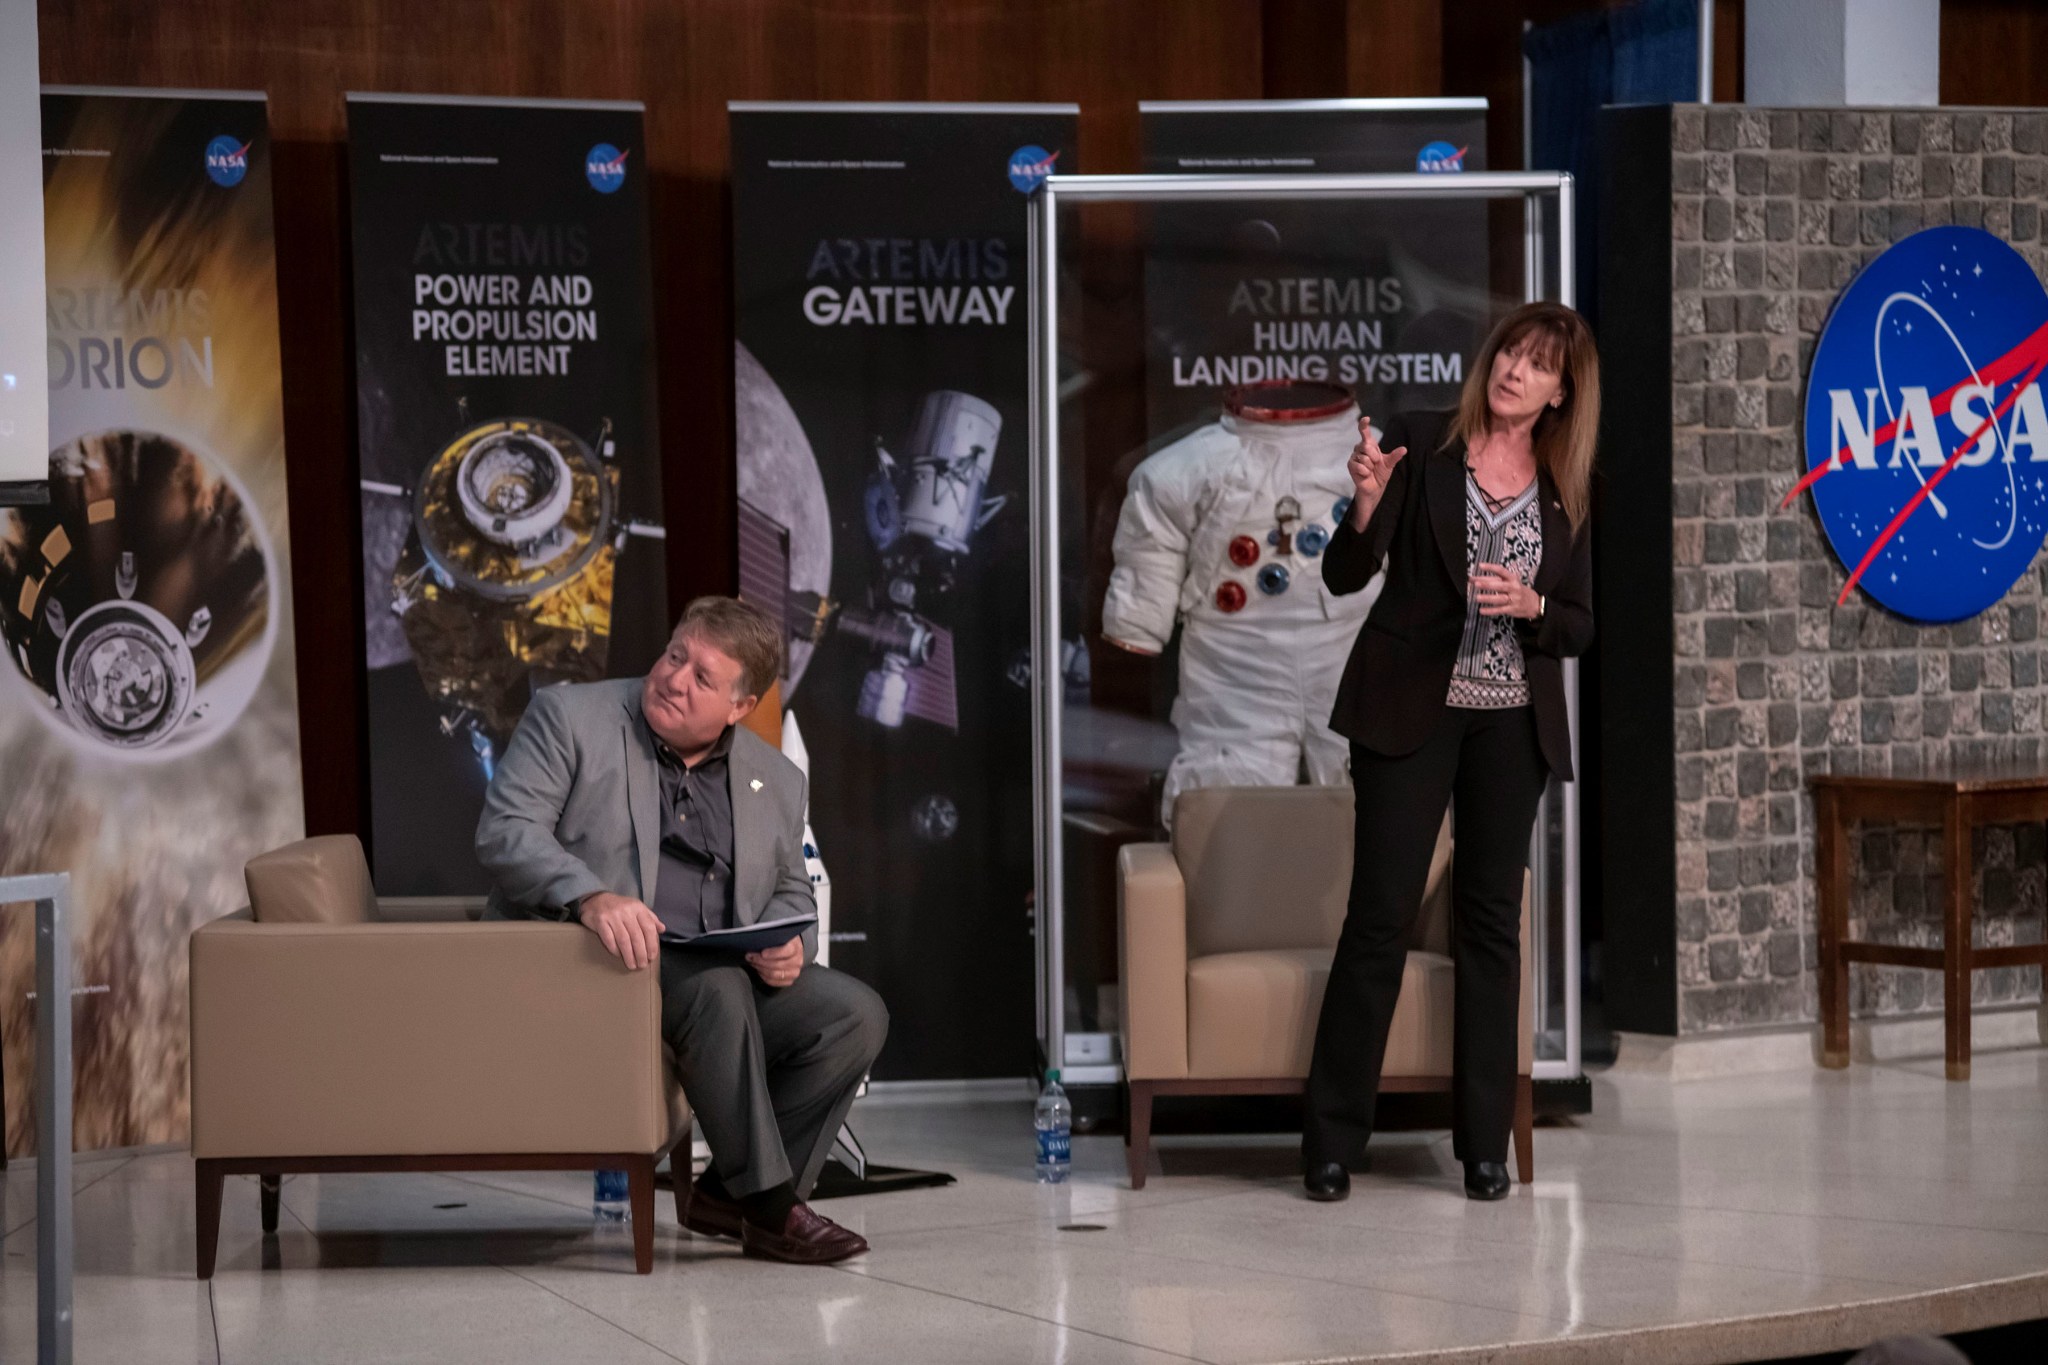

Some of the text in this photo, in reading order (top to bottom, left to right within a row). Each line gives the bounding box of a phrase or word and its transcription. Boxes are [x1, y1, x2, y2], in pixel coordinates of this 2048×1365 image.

[208, 155, 246, 168] NASA
[588, 162, 624, 174] NASA
[1011, 163, 1053, 176] NASA
[1420, 159, 1461, 172] NASA
[412, 222, 590, 267] ARTEMIS
[806, 237, 1008, 280] ARTEMIS
[415, 273, 593, 306] POWER AND
[803, 285, 1015, 325] GATEWAY
[1227, 277, 1402, 316] ARTEMIS
[412, 309, 597, 341] PROPULSION
[1253, 320, 1382, 350] HUMAN
[446, 344, 571, 376] ELEMENT
[1172, 353, 1462, 386] LANDING SYSTEM
[1827, 380, 2048, 471] NASA
